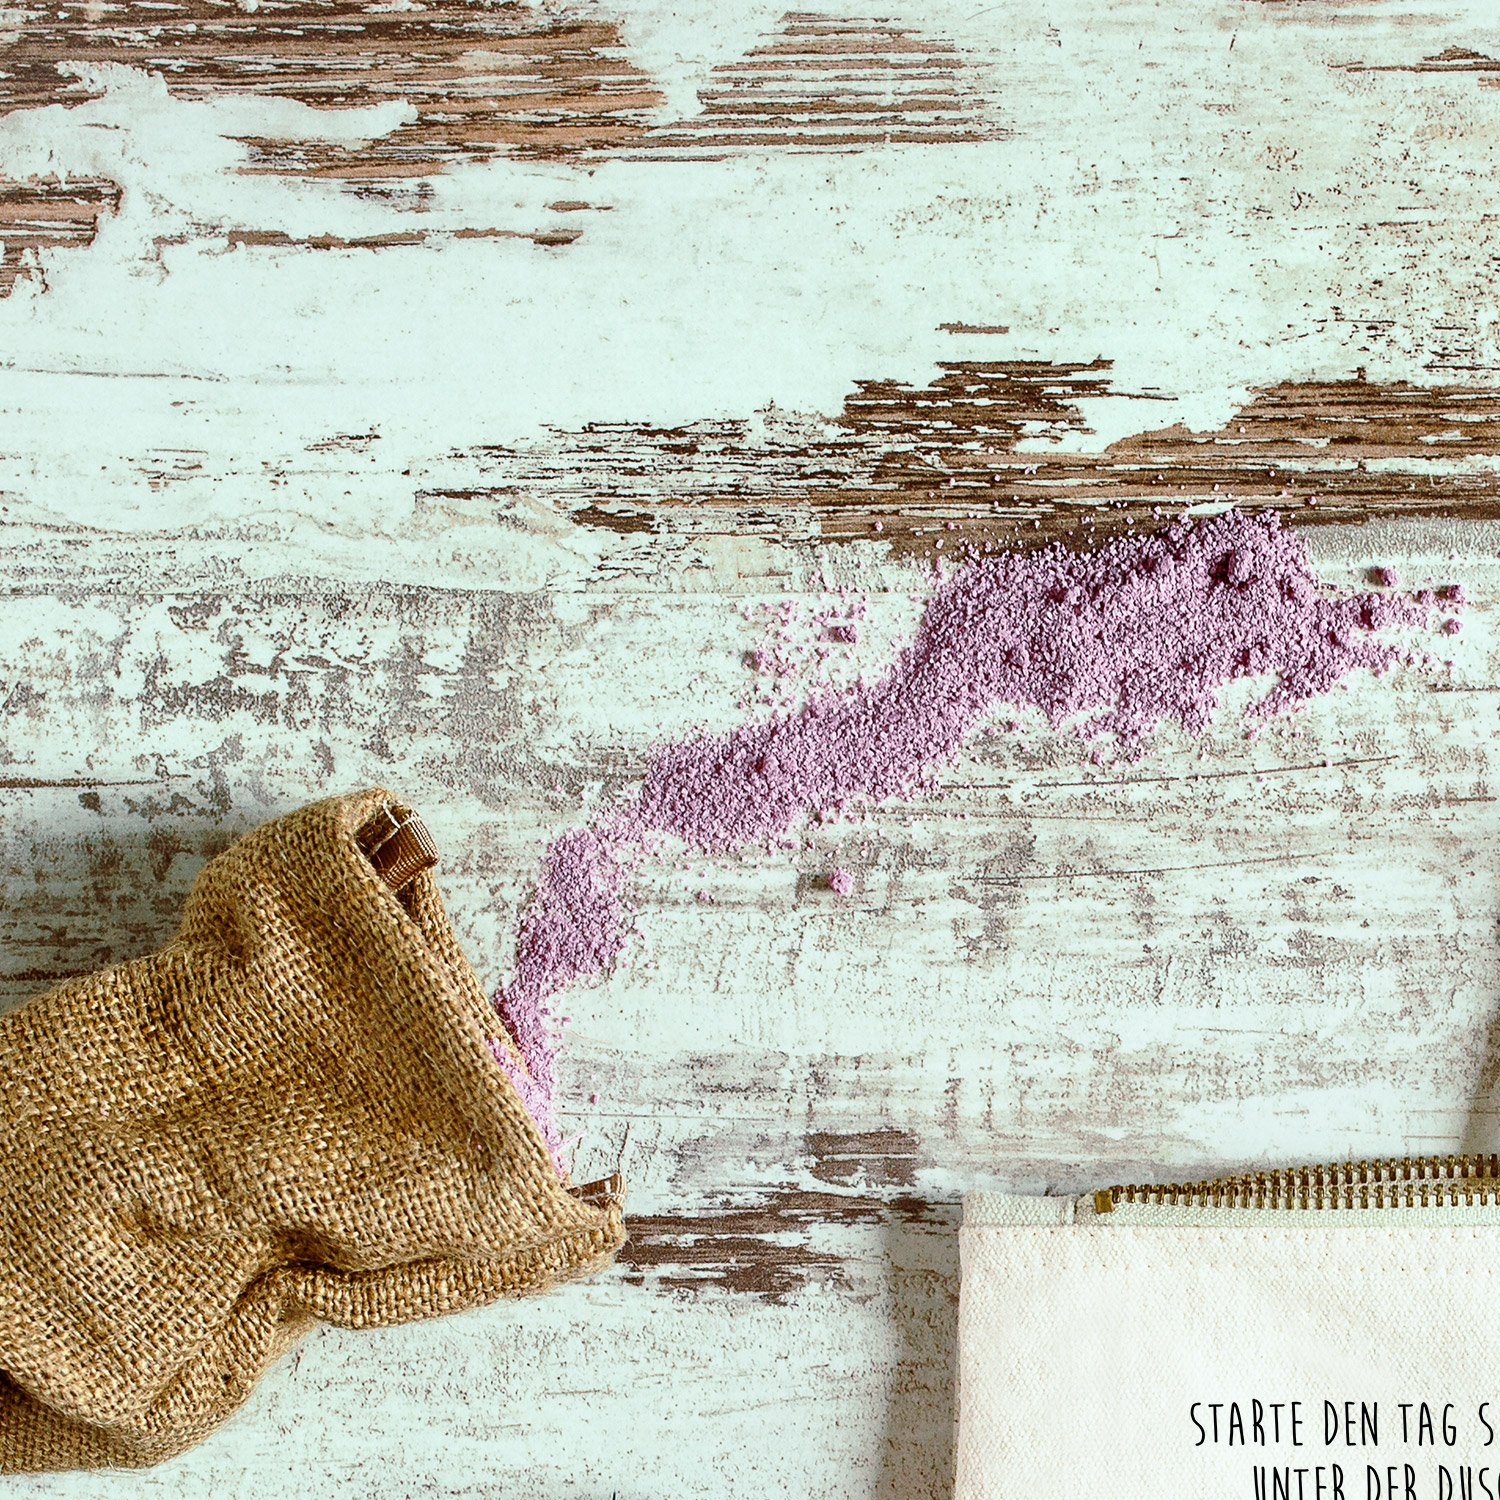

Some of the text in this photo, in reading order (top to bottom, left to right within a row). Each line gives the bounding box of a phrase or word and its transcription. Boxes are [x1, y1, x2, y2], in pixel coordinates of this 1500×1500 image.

[1190, 1398, 1304, 1447] STARTE
[1324, 1399, 1379, 1447] DEN
[1397, 1401, 1458, 1447] TAG
